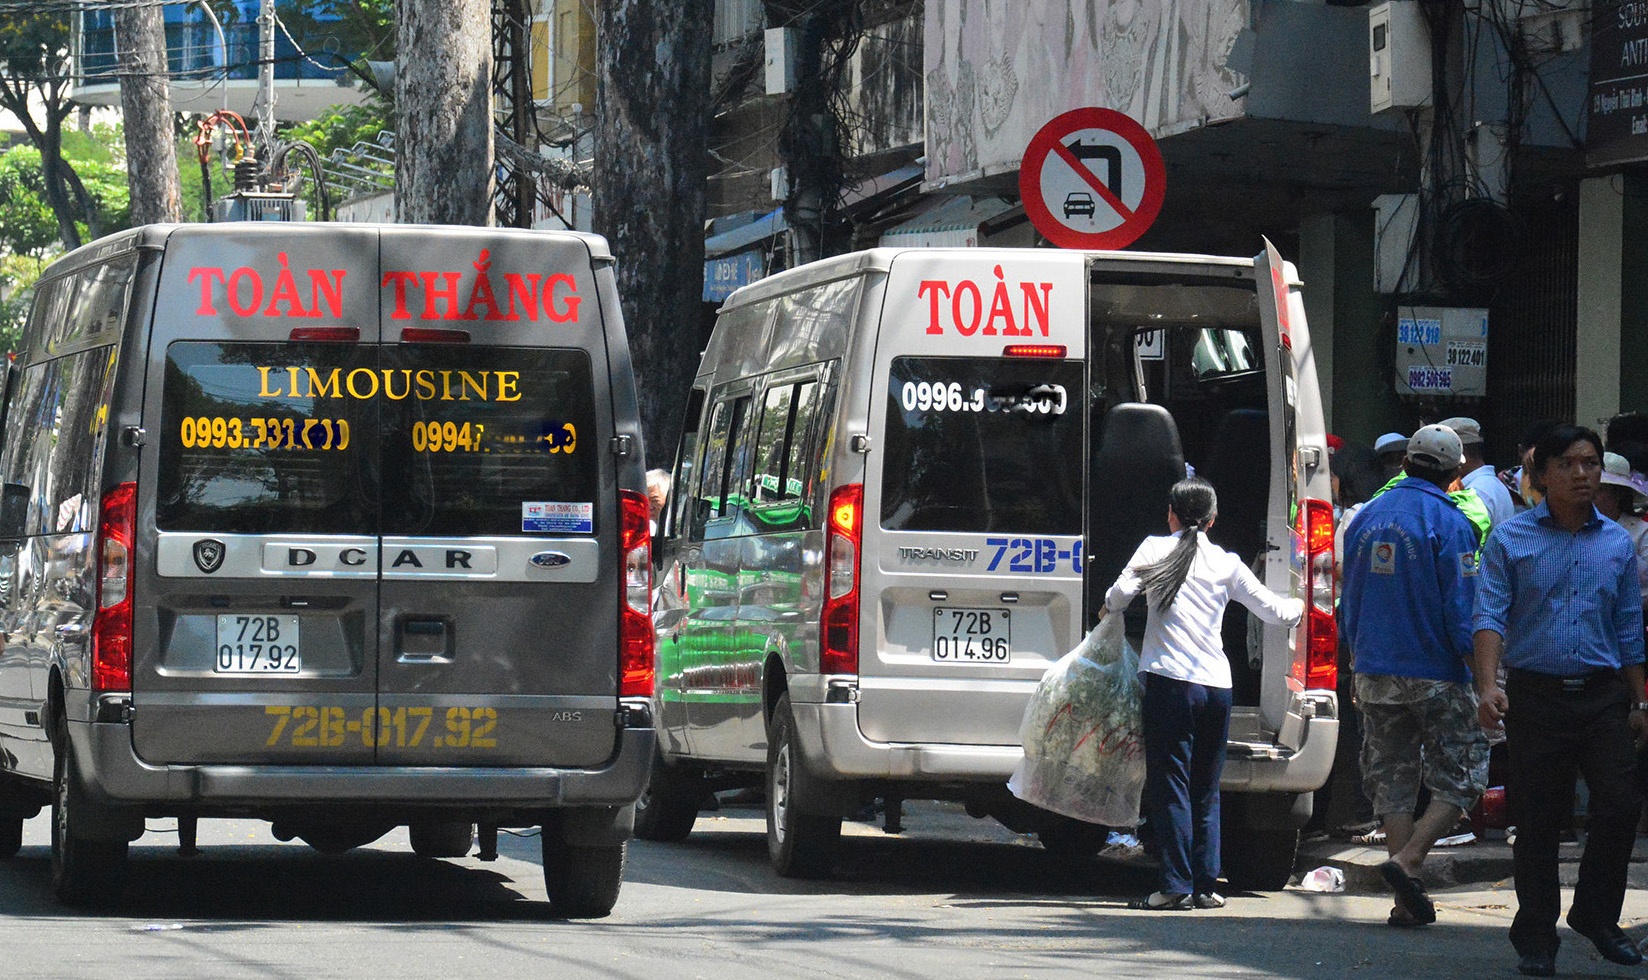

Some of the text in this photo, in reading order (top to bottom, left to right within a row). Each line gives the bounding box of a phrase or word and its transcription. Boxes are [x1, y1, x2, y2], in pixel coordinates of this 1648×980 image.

[187, 248, 582, 323] TOÀN THẮNG
[918, 264, 1053, 337] TOÀN
[257, 366, 522, 401] LIMOUSINE
[900, 547, 980, 561] TRANSIT
[236, 617, 280, 642] 72B
[952, 611, 992, 635] 72B
[219, 644, 297, 669] 017.92
[936, 636, 1008, 660] 014.96
[265, 706, 497, 748] 72B-017.92
[552, 711, 582, 722] ABS
